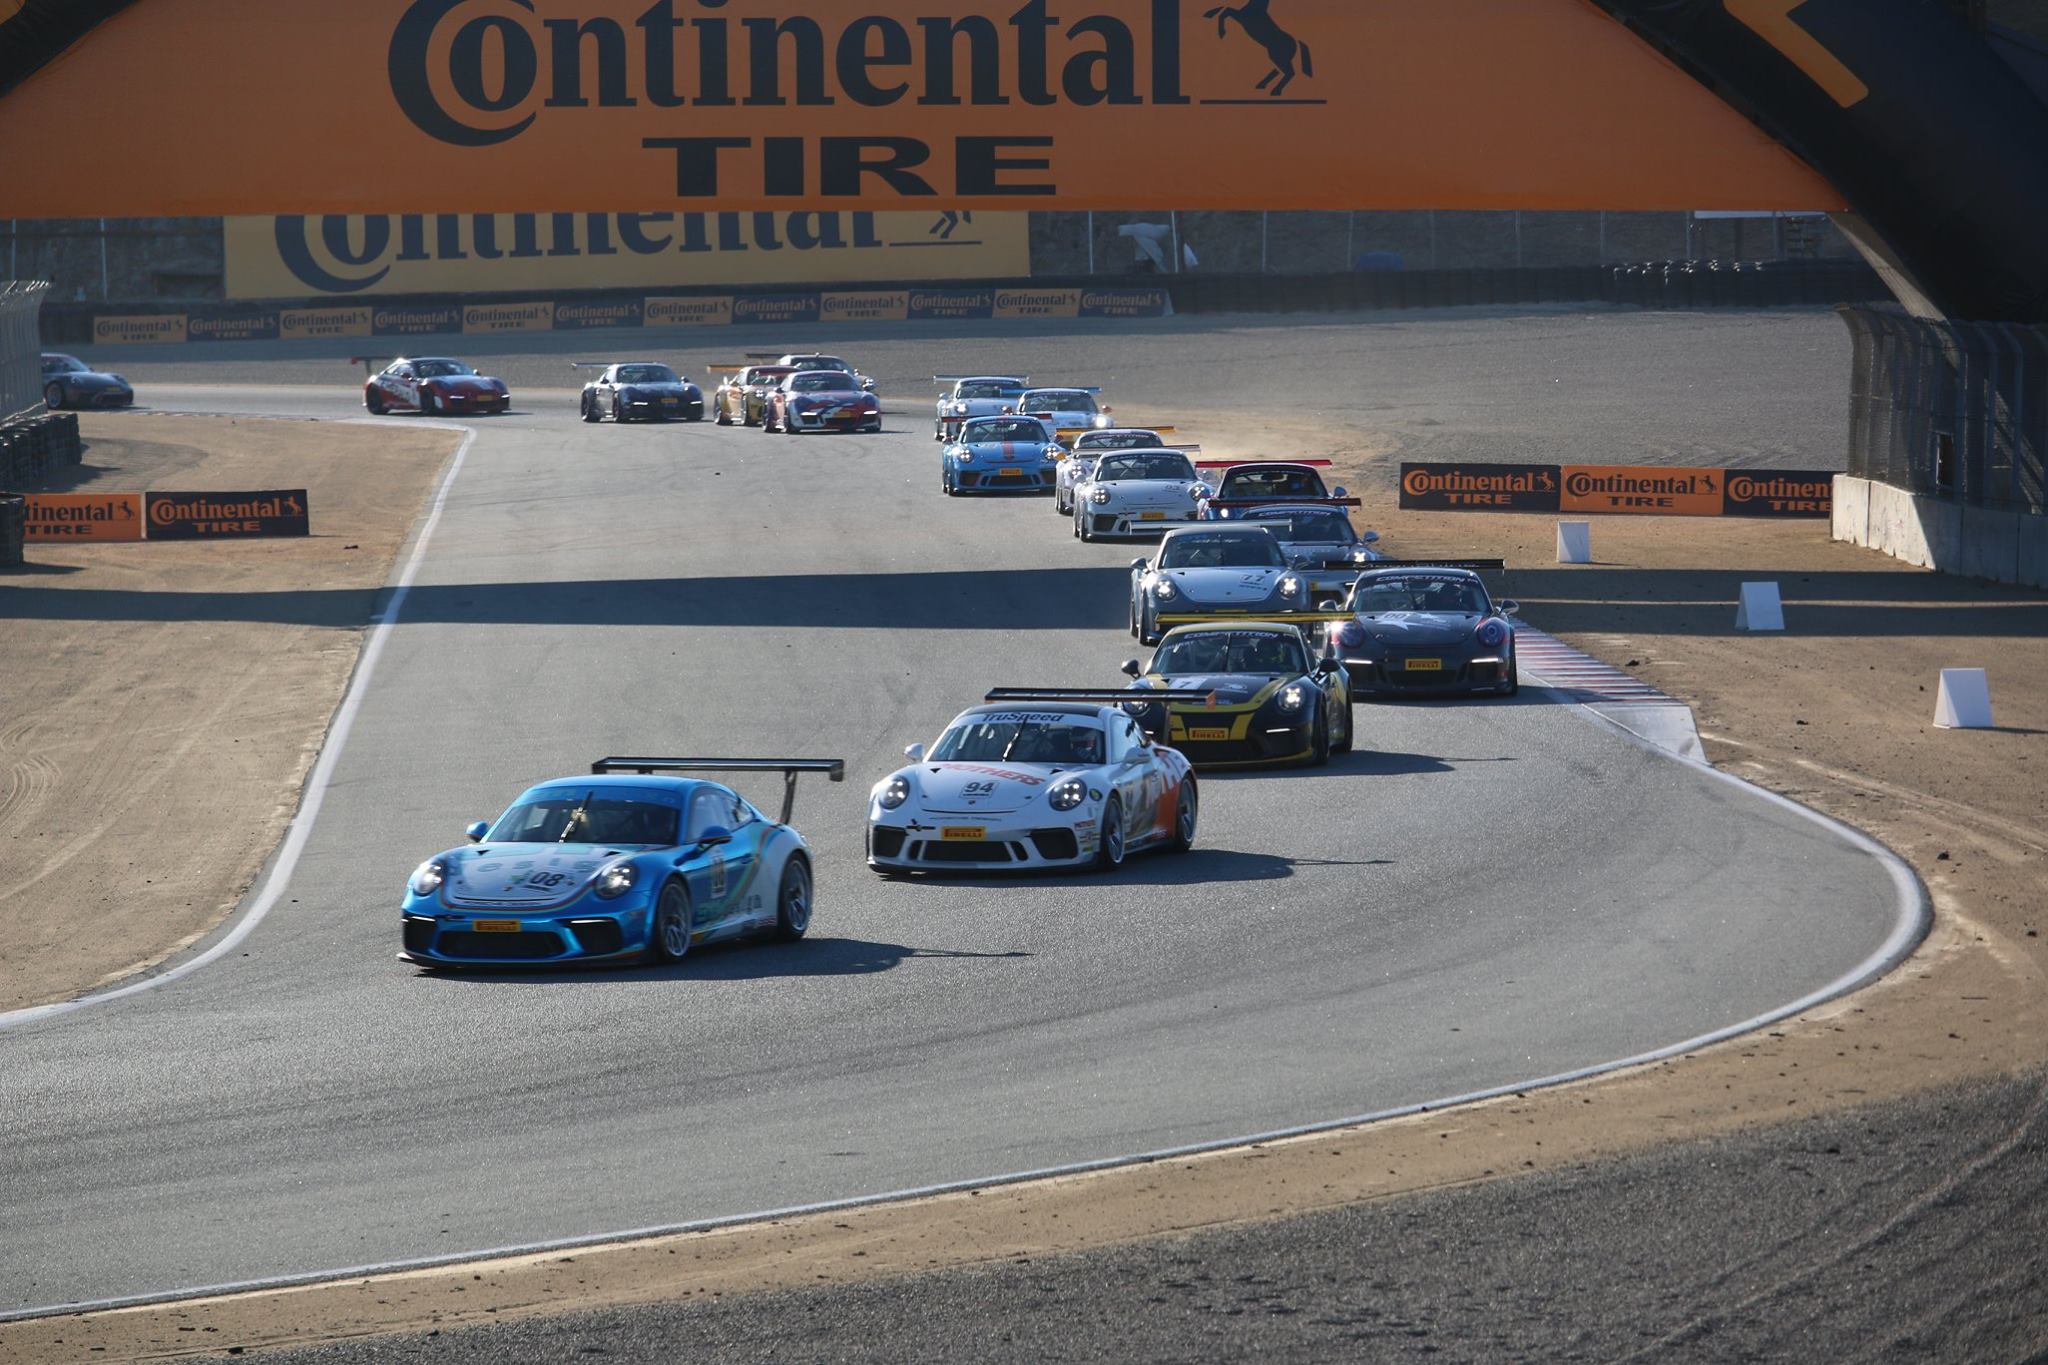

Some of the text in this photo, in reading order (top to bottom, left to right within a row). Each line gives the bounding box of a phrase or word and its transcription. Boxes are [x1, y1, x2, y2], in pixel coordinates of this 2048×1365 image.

[388, 0, 1191, 147] Continental
[642, 136, 1057, 197] TIRE
[735, 299, 807, 316] Continental
[824, 296, 894, 313] Continental
[911, 293, 980, 310] Continental
[997, 292, 1067, 309] Continental
[1082, 291, 1151, 309] Continental
[466, 307, 538, 324] Continental
[556, 304, 628, 321] Continental
[647, 301, 718, 318] Continental
[190, 317, 265, 334] Continental
[283, 313, 356, 331] Continental
[375, 310, 448, 328] Continental
[97, 320, 171, 337] Continental
[1404, 470, 1534, 496] Continental
[1566, 472, 1696, 497] Continental
[1728, 476, 1833, 502] Continen
[1444, 493, 1512, 505] TIRE
[1606, 496, 1674, 508] TIRE
[1768, 500, 1832, 512] TIRE
[25, 502, 113, 521] tinental
[150, 497, 281, 526] Continental
[25, 524, 93, 535] TIRE
[192, 521, 262, 533] TIRE
[1184, 631, 1278, 640] COMPETITION
[983, 712, 1065, 722] TruSpeed
[1191, 730, 1226, 739] PIRELLI
[964, 781, 996, 793] 94
[943, 828, 983, 838] PIRELLI
[528, 871, 566, 888] 08
